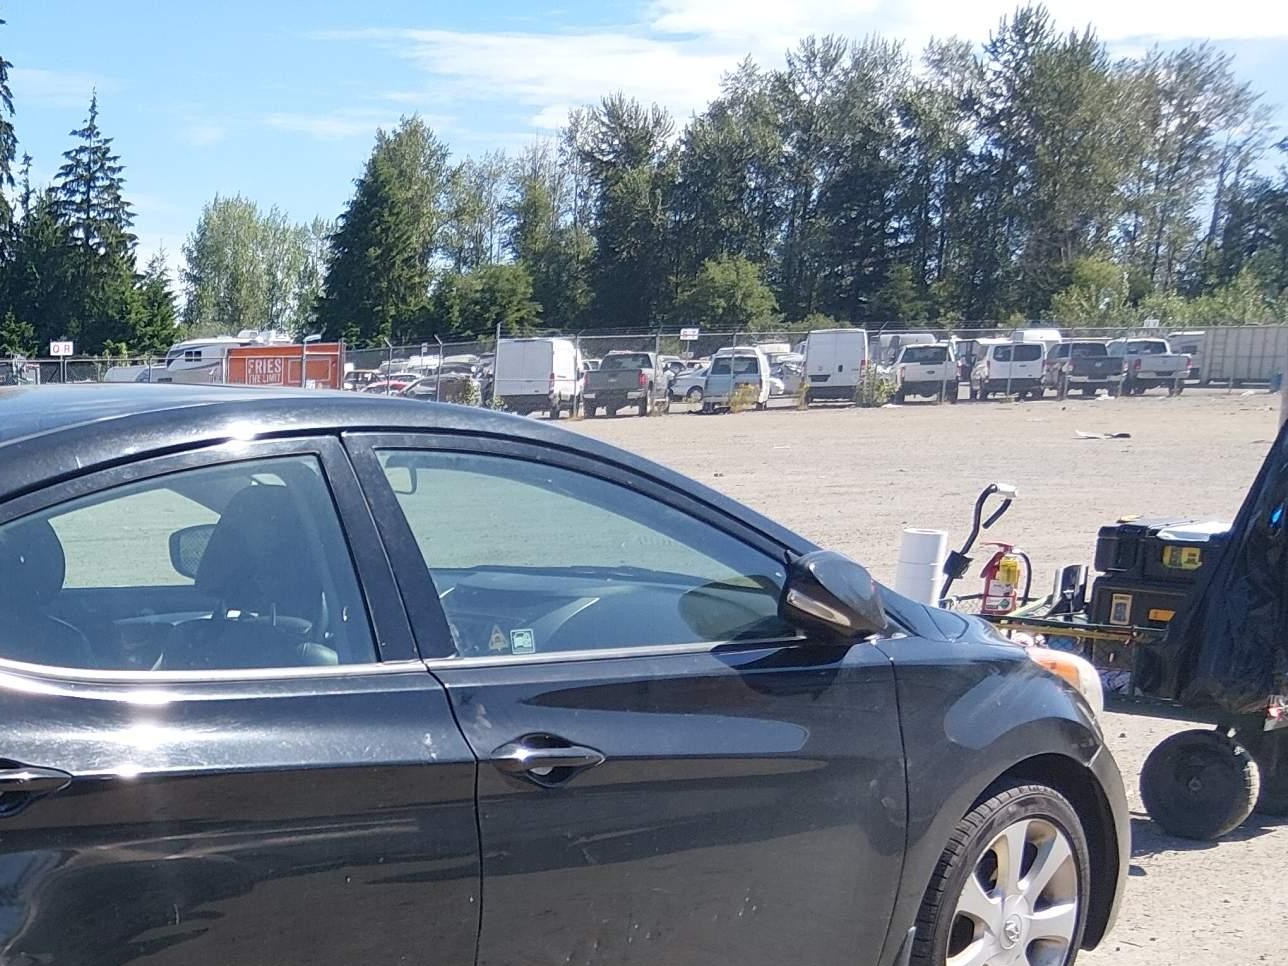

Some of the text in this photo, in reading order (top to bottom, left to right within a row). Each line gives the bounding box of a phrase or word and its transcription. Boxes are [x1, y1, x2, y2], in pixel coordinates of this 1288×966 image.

[248, 358, 281, 374] FRIES
[249, 372, 281, 384] THE LIMIT
